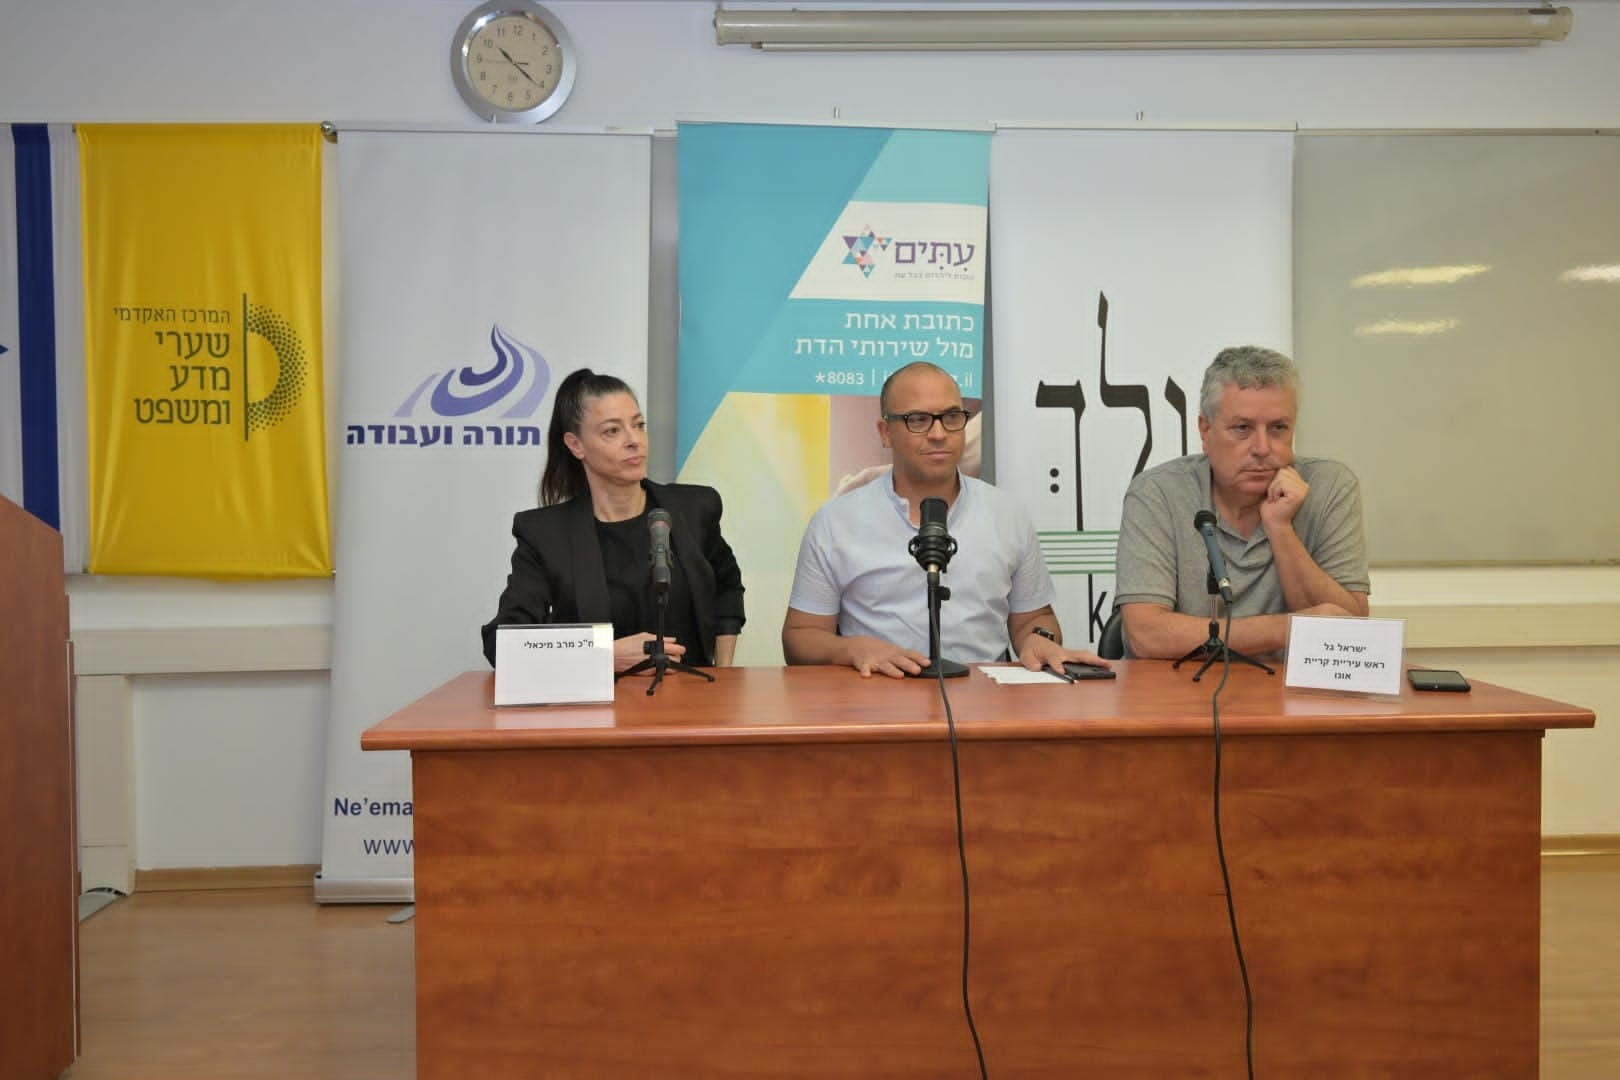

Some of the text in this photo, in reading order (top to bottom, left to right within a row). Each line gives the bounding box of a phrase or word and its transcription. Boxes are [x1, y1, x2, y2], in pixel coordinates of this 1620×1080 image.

[513, 25, 523, 36] 12
[484, 39, 493, 48] 10
[542, 45, 549, 56] 2
[546, 64, 552, 74] 3
[480, 71, 486, 81] 8
[113, 306, 231, 325] המרכז האקדמי
[845, 312, 975, 332] כתובת אחת
[155, 331, 230, 360] שערי
[794, 336, 974, 359] מול שירותי הדת
[170, 365, 230, 392] מדע
[134, 398, 231, 425] ומשפט
[346, 424, 541, 448] תורה ועבודה
[524, 641, 553, 649] מיכאלי
[556, 641, 575, 649] מרב
[1323, 642, 1367, 653] ישראל גל
[1303, 657, 1385, 669] ראש עיריית קריית
